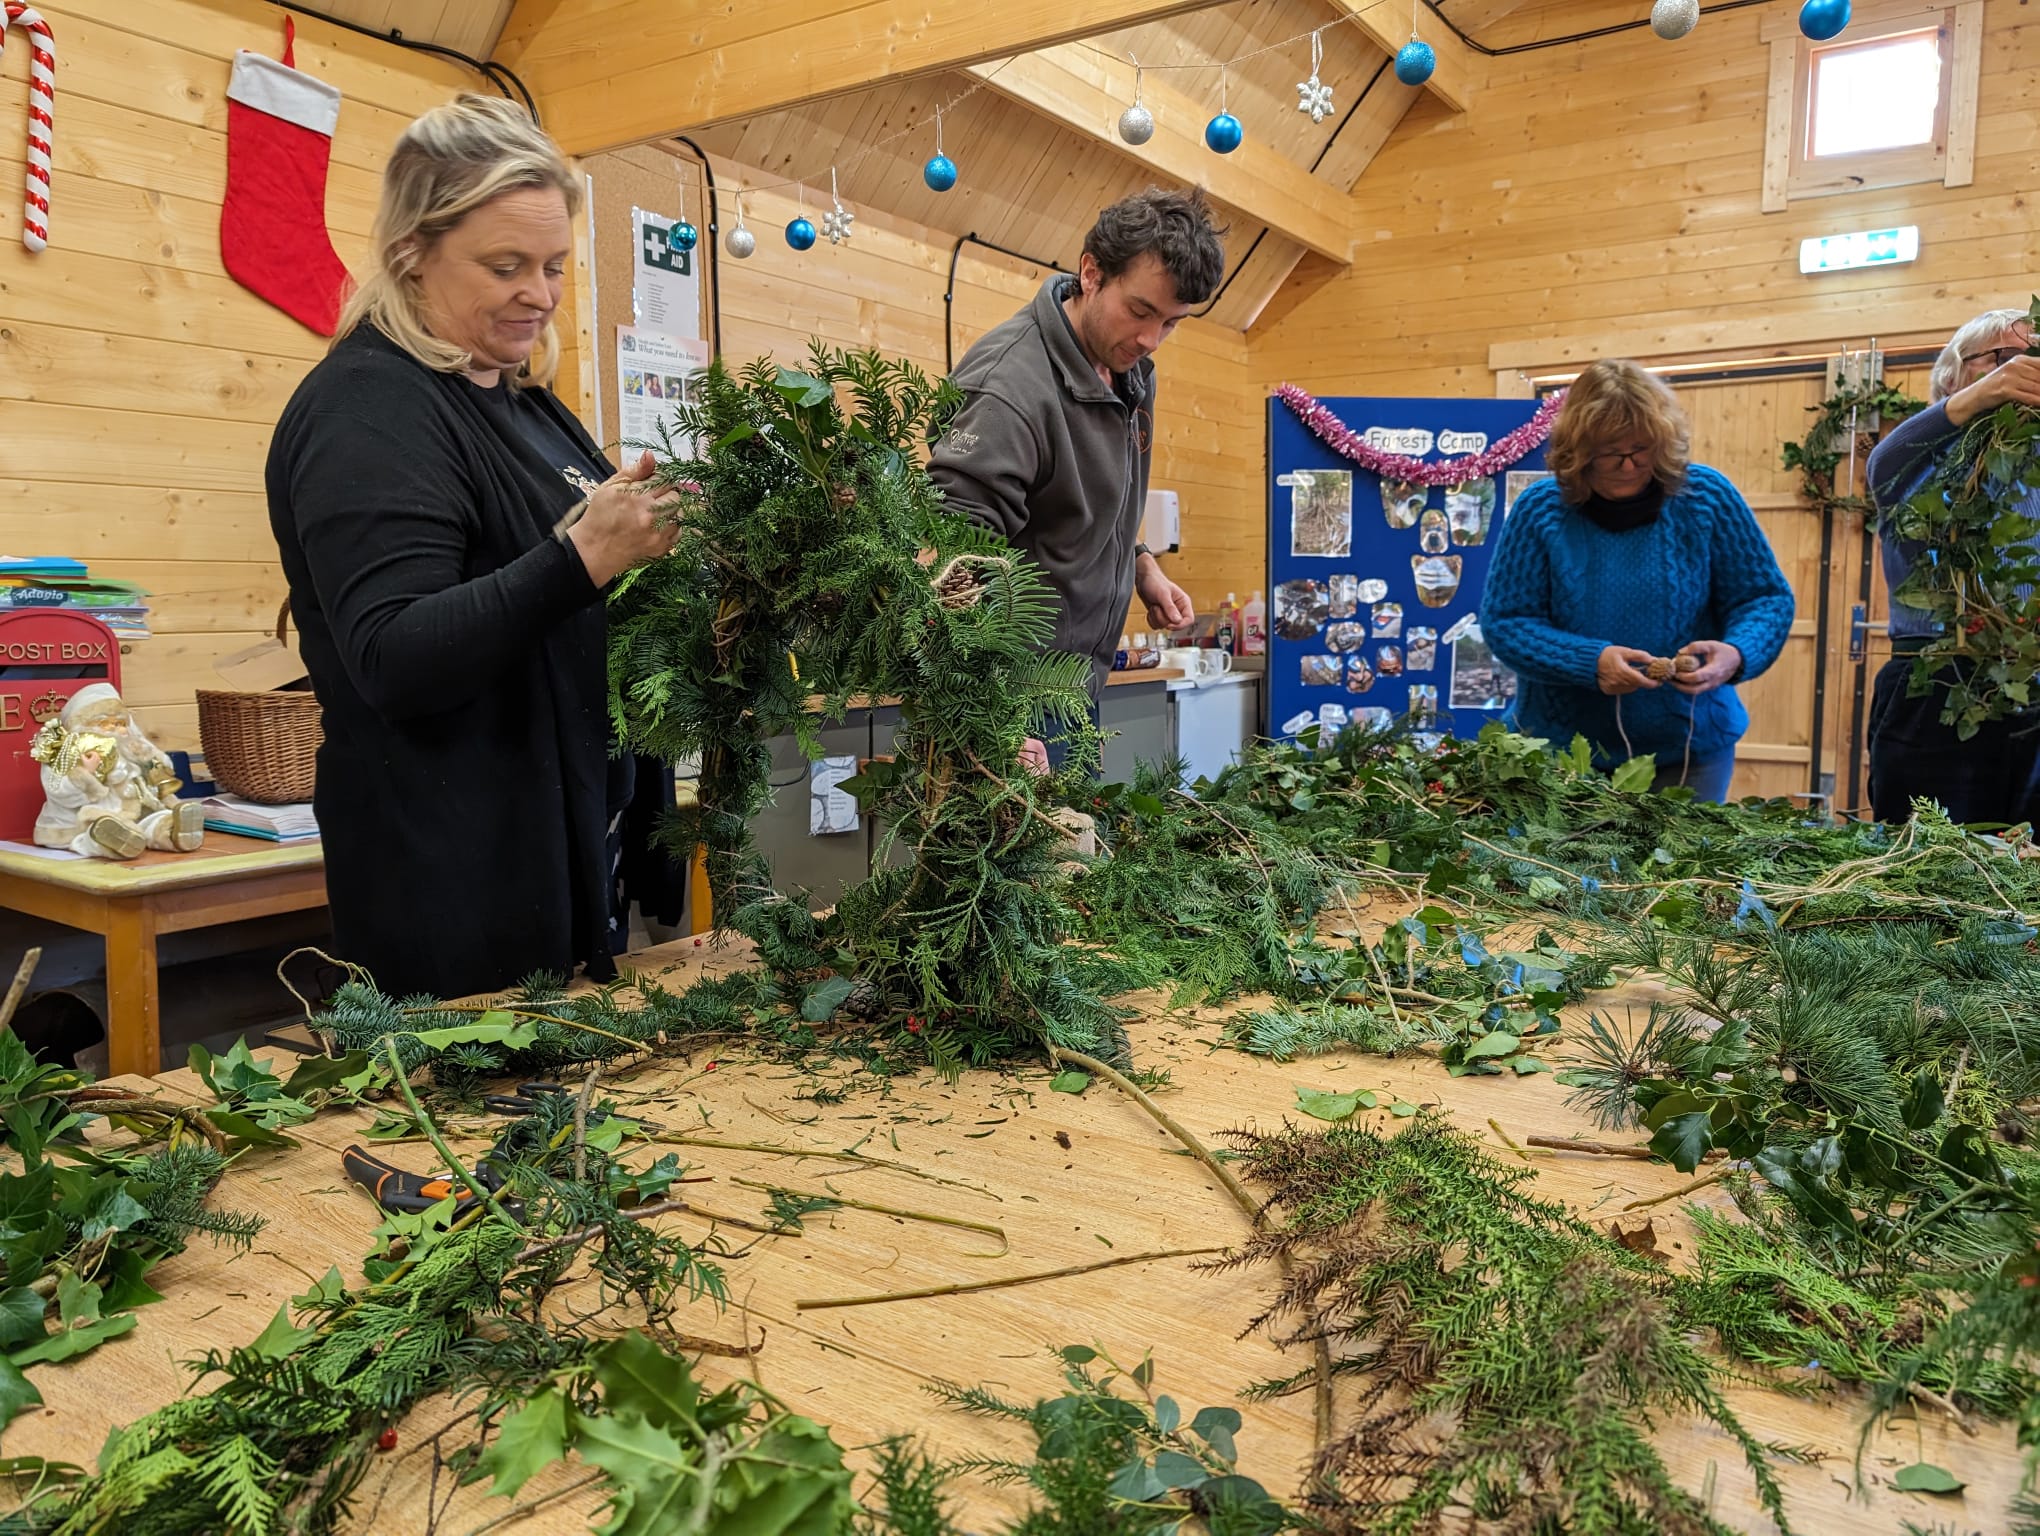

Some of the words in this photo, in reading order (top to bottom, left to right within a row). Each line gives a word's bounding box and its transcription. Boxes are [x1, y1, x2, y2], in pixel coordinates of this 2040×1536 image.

[671, 254, 684, 269] AID
[1370, 431, 1428, 449] Forest
[1440, 433, 1484, 453] Camp
[16, 588, 64, 601] Adagio
[62, 643, 107, 660] BOX
